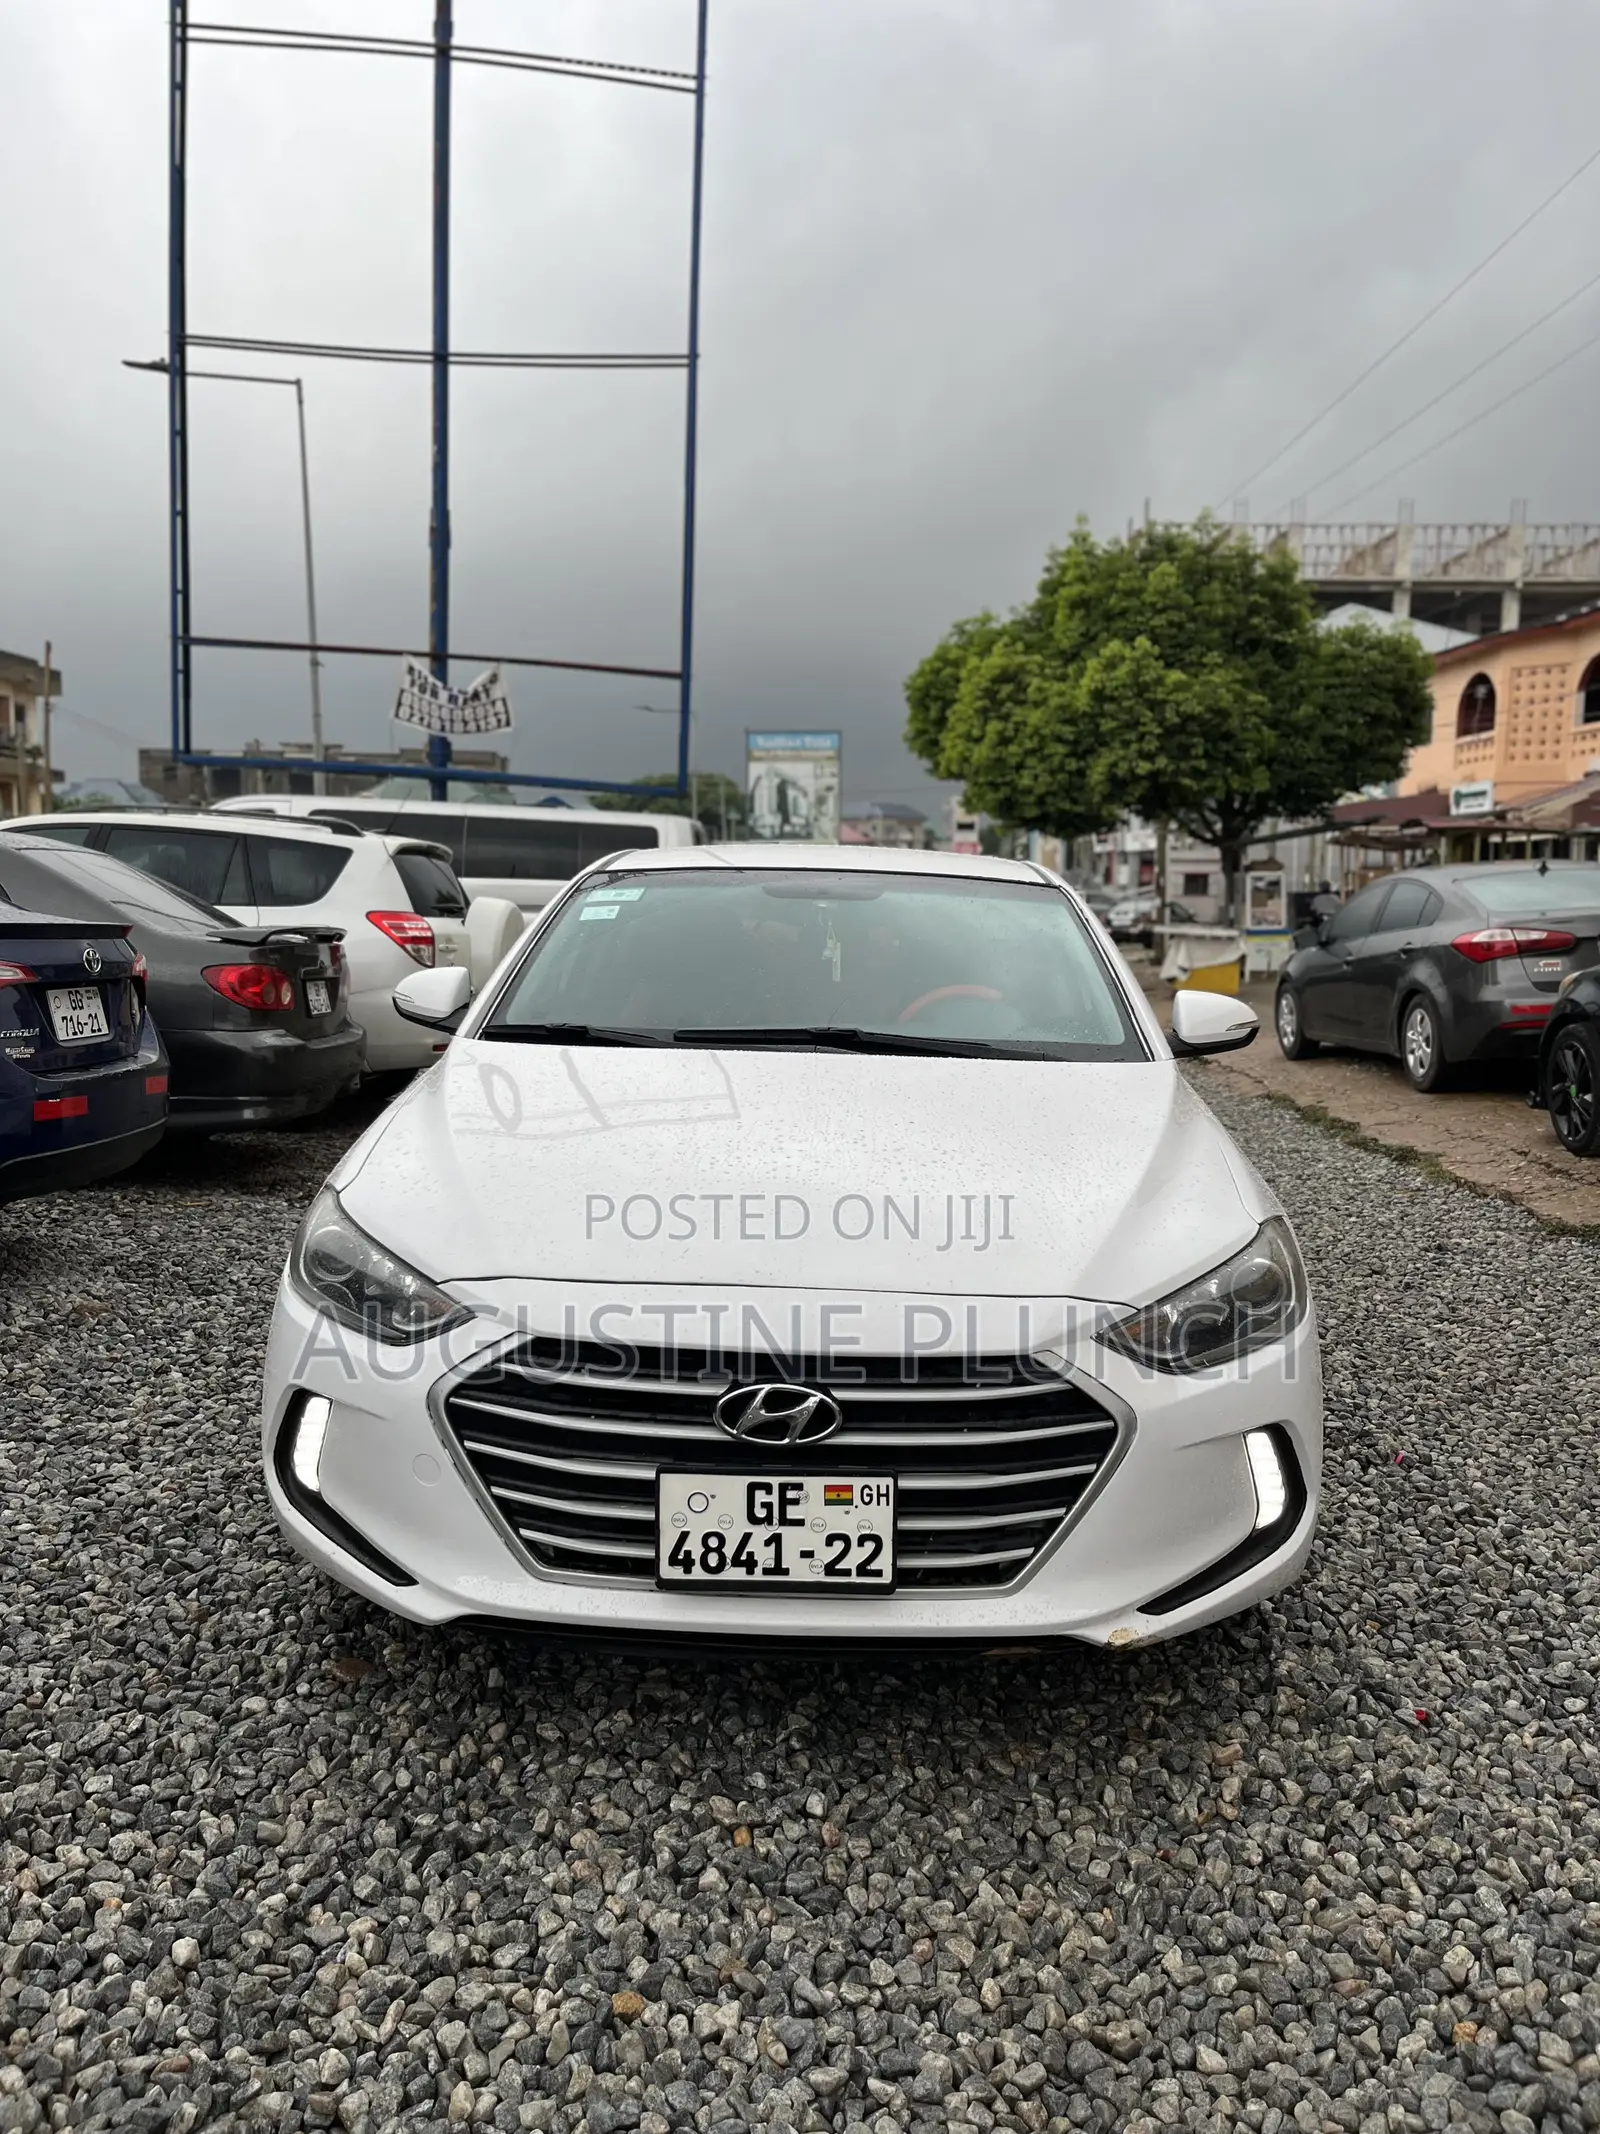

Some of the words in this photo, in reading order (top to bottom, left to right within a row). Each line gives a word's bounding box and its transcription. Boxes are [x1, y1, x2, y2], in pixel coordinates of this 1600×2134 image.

[67, 990, 84, 1011] GG
[0, 1028, 40, 1038] COROLLA
[61, 1012, 102, 1037] 716-21
[746, 1481, 805, 1527] GE
[859, 1484, 890, 1507] GH
[668, 1530, 884, 1578] 4841-22
